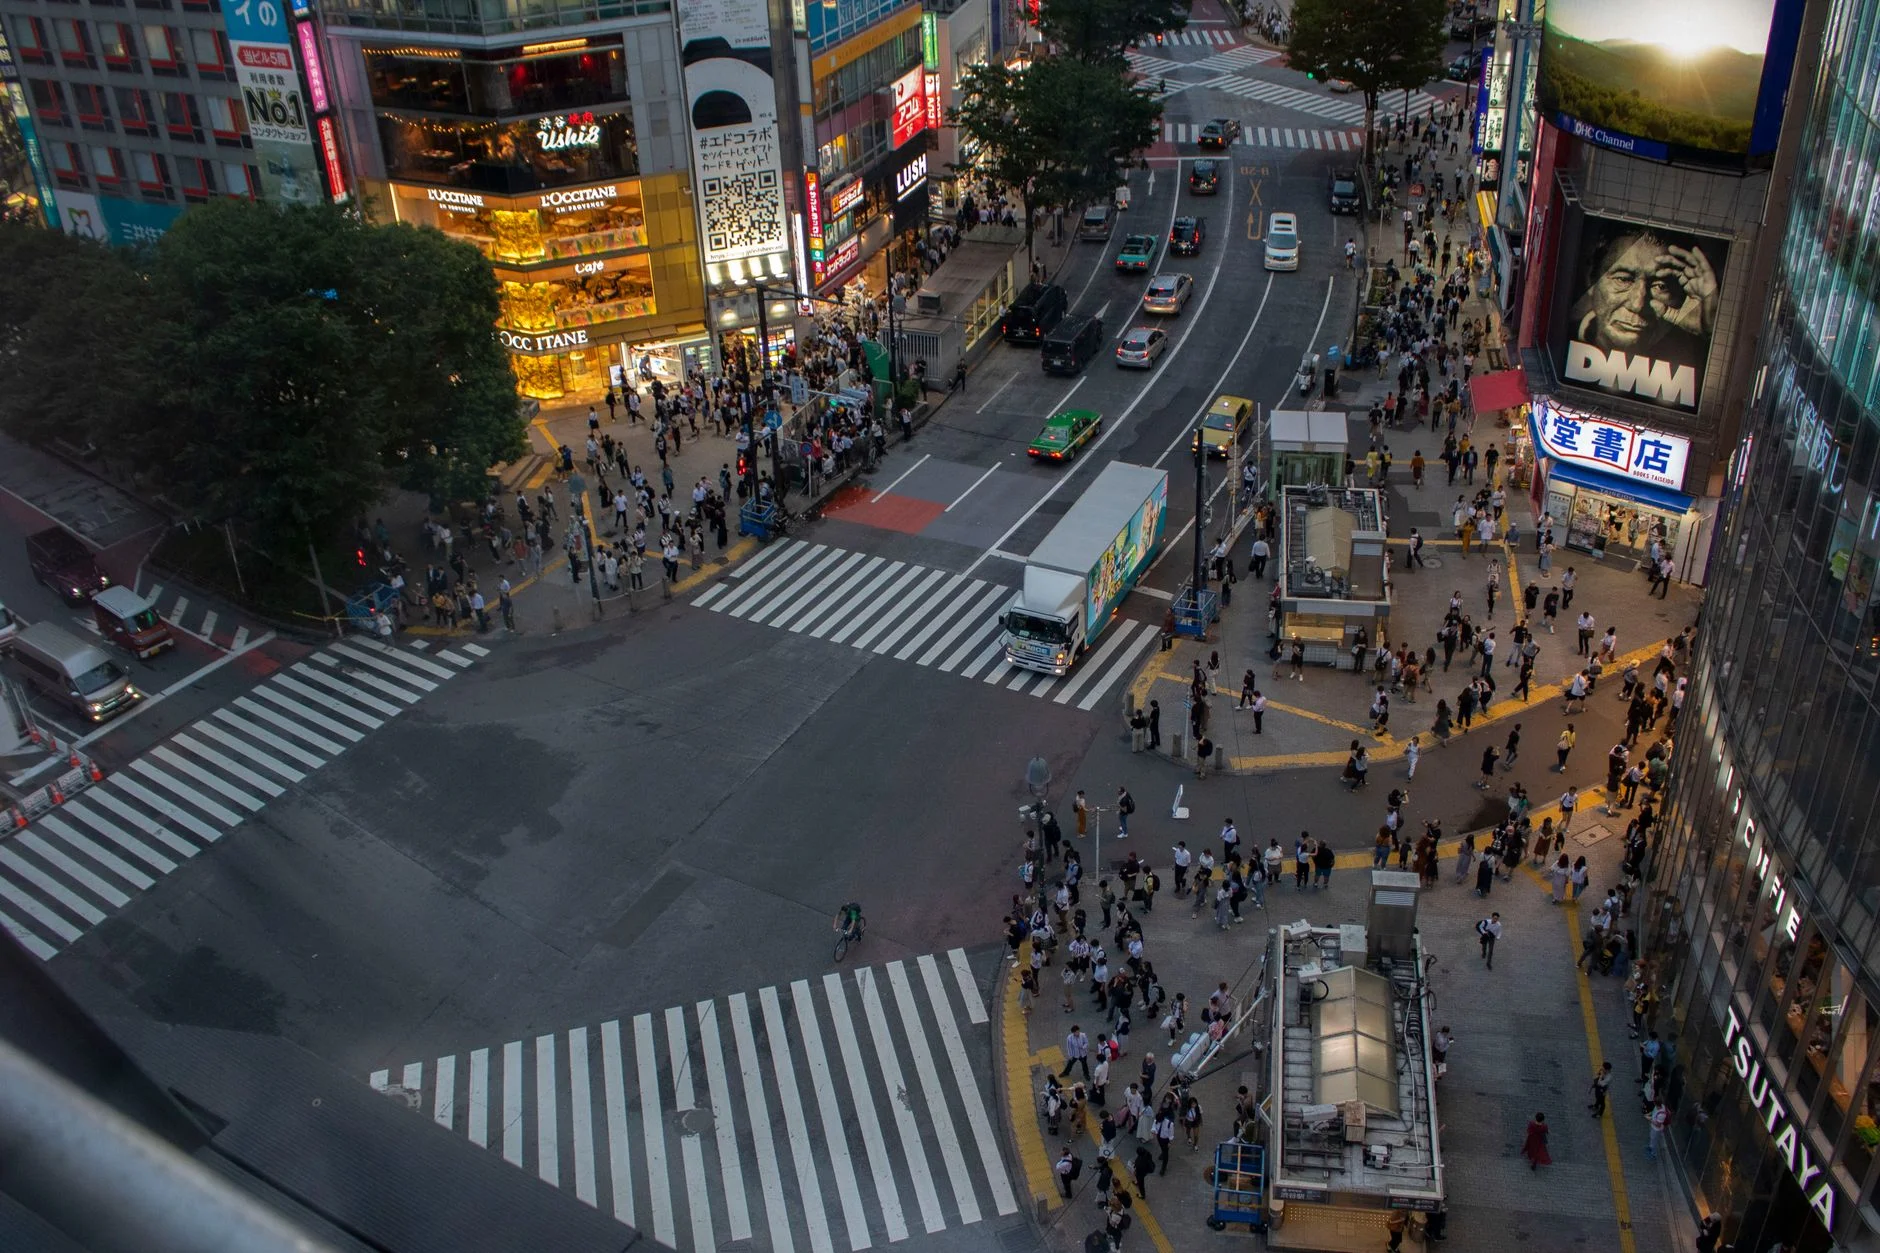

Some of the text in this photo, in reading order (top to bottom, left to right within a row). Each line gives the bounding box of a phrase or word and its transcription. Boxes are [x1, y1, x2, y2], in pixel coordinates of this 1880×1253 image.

[242, 86, 307, 130] No.1
[899, 97, 919, 126] アコム
[251, 127, 307, 142] コンタクトショップ
[536, 125, 600, 150] Ushi8
[700, 126, 773, 150] #エドコラボ
[1574, 119, 1634, 151] DHC Channel
[896, 153, 928, 194] LUSH
[427, 188, 485, 207] L'OCCITANE
[540, 186, 617, 208] L'OCCITANE
[575, 259, 605, 275] Café
[1564, 340, 1696, 407] DMM
[1633, 470, 1675, 486] BOOKS TAISEIDO
[1725, 1004, 1836, 1234] TSUTAYA
